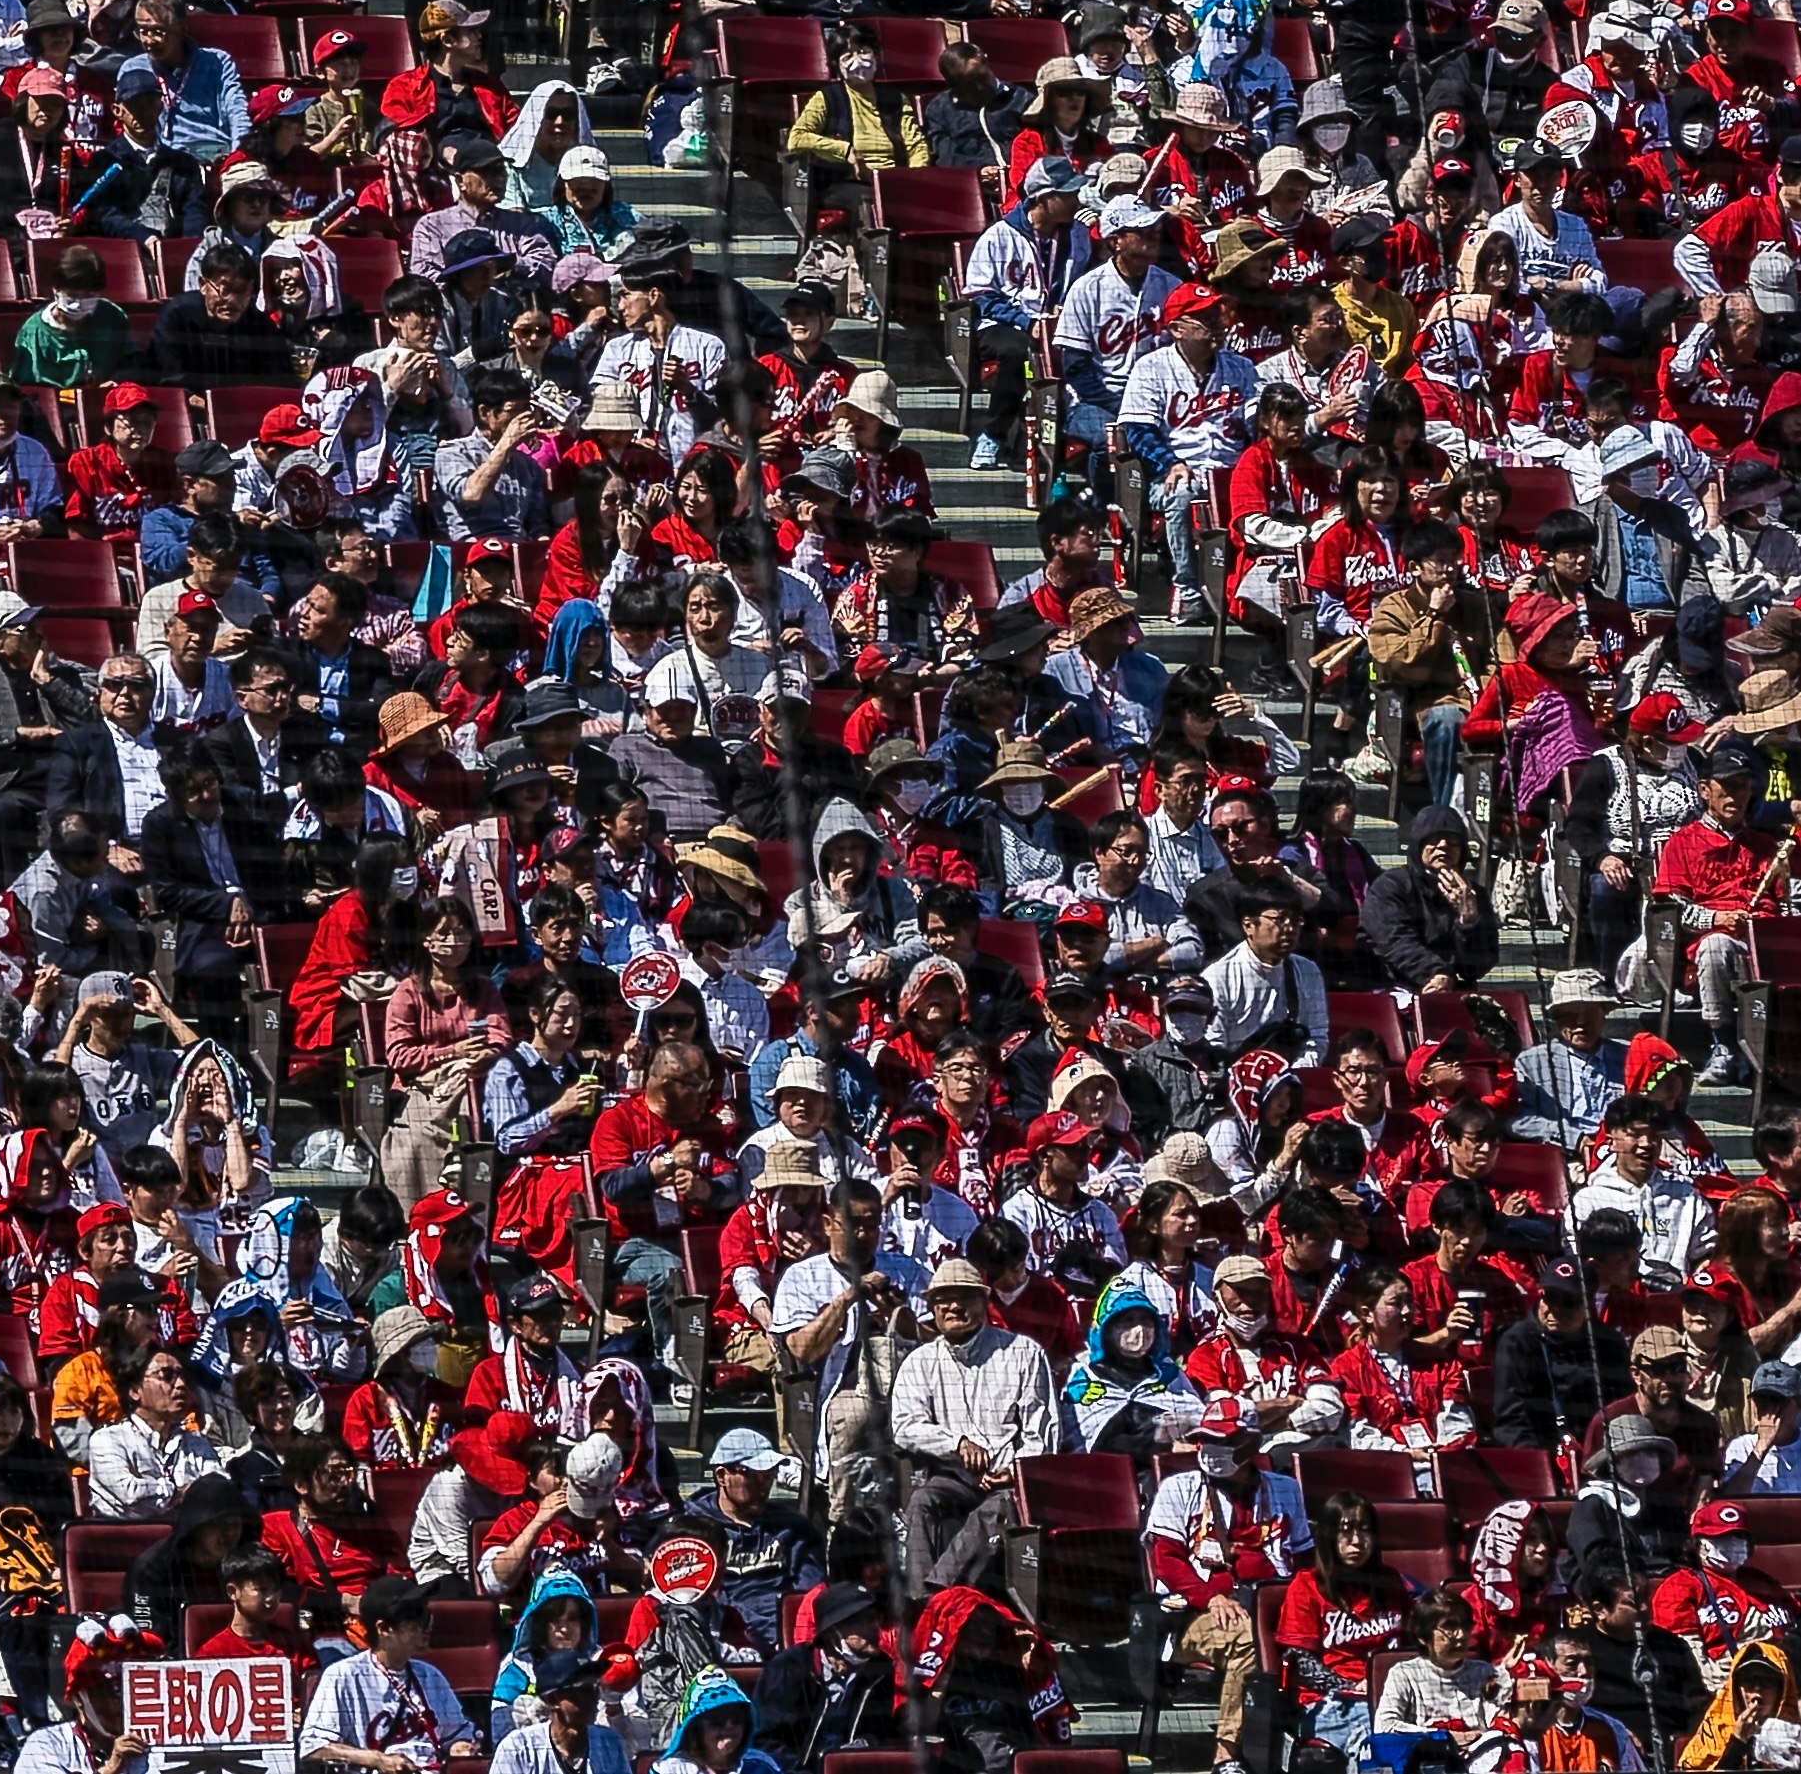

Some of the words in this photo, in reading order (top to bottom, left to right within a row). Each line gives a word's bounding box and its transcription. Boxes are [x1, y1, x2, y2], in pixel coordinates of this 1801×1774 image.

[1005, 260, 1037, 291] CA
[480, 876, 500, 923] CARP
[128, 1664, 288, 1745] 鳥取の星
